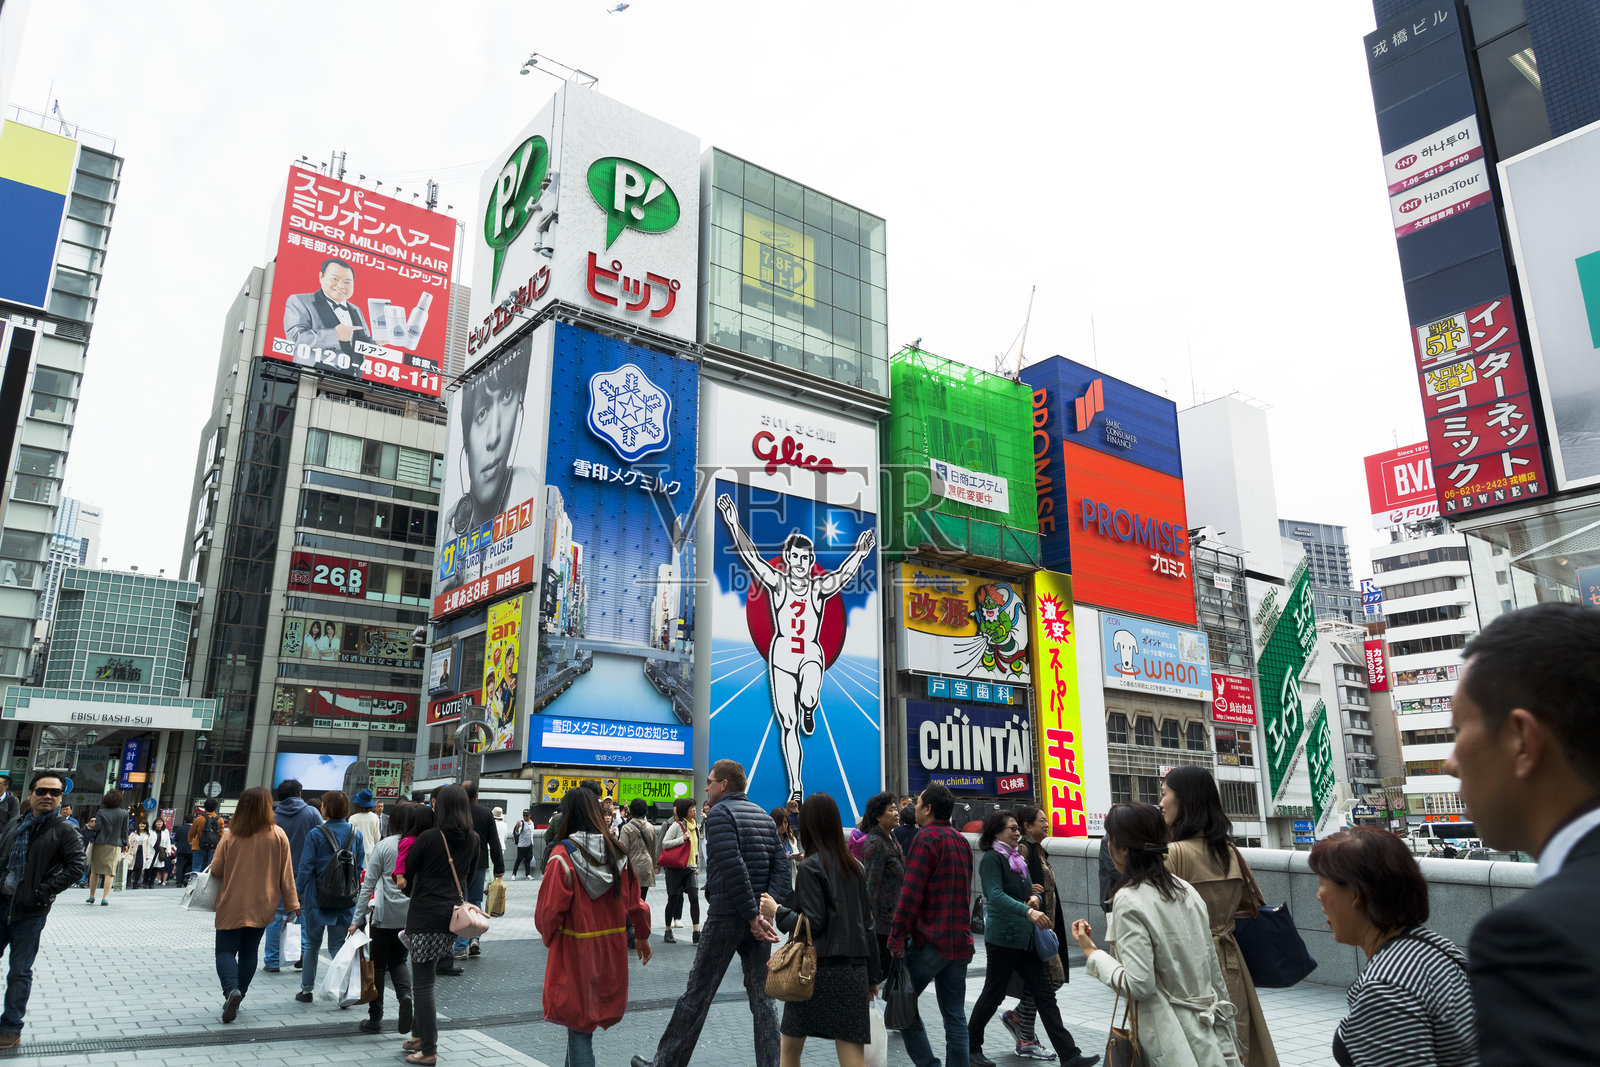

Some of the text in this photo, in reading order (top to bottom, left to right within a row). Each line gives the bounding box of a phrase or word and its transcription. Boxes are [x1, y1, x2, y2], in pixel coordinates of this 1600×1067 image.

[1372, 9, 1448, 58] 戎橋ビル
[1421, 129, 1470, 157] 하나투어
[294, 172, 386, 211] スーパー
[613, 160, 666, 220] P!
[1424, 174, 1480, 203] HanaTour
[292, 192, 450, 252] ミリオンヘアー
[289, 215, 448, 272] SUPER MILLION HAIR
[587, 250, 681, 319] ピップ
[1429, 317, 1457, 336] 当ビル
[357, 343, 387, 356] ルアン
[1425, 326, 1466, 357] 5F
[298, 343, 438, 391] 0120-494-111
[1428, 364, 1464, 384] 入口は
[1434, 375, 1461, 393] 右奥
[1469, 300, 1531, 478] インターネット
[1105, 418, 1122, 430] SMBC
[1105, 427, 1138, 444] CONSUMER
[1436, 388, 1480, 489] コミック
[752, 430, 847, 476] Glico
[1106, 434, 1133, 450] FINANCE
[572, 458, 681, 495] 雪印メグミルク
[951, 470, 1003, 494] 日商エステム
[1444, 478, 1508, 499] 06-6212-2423
[948, 484, 993, 506] 意匠変更中
[1406, 503, 1440, 519] FUJI
[443, 500, 532, 575] サタデープラス
[1082, 497, 1185, 557] PROMISE
[489, 540, 506, 559] PLUS
[1150, 552, 1187, 579] プロミス
[443, 579, 490, 613] 土曜あさ8時
[496, 566, 520, 591] MBS
[912, 570, 964, 595] かぜに
[907, 591, 970, 627] 改源
[1044, 600, 1065, 639] 激安
[491, 620, 516, 641] an
[789, 598, 808, 655] グリコ
[96, 665, 142, 682] 戎橋筋
[1143, 658, 1198, 685] WAON
[1366, 649, 1377, 684] JOYSOUND
[1373, 648, 1386, 683] カラオケ
[933, 679, 1010, 701] 戸堂歯科
[1048, 648, 1067, 729] スーパー
[71, 711, 153, 725] EBISU BASHI-SUJI
[552, 719, 678, 741] 雪印メグミルクからのお知らせ
[1268, 664, 1302, 770] エイブル
[919, 707, 1031, 774] CHINTAI
[388, 788, 398, 796] 2F
[642, 781, 671, 798] ピタットハウス
[1009, 777, 1025, 789] 検索
[1046, 728, 1089, 838] 玉出
